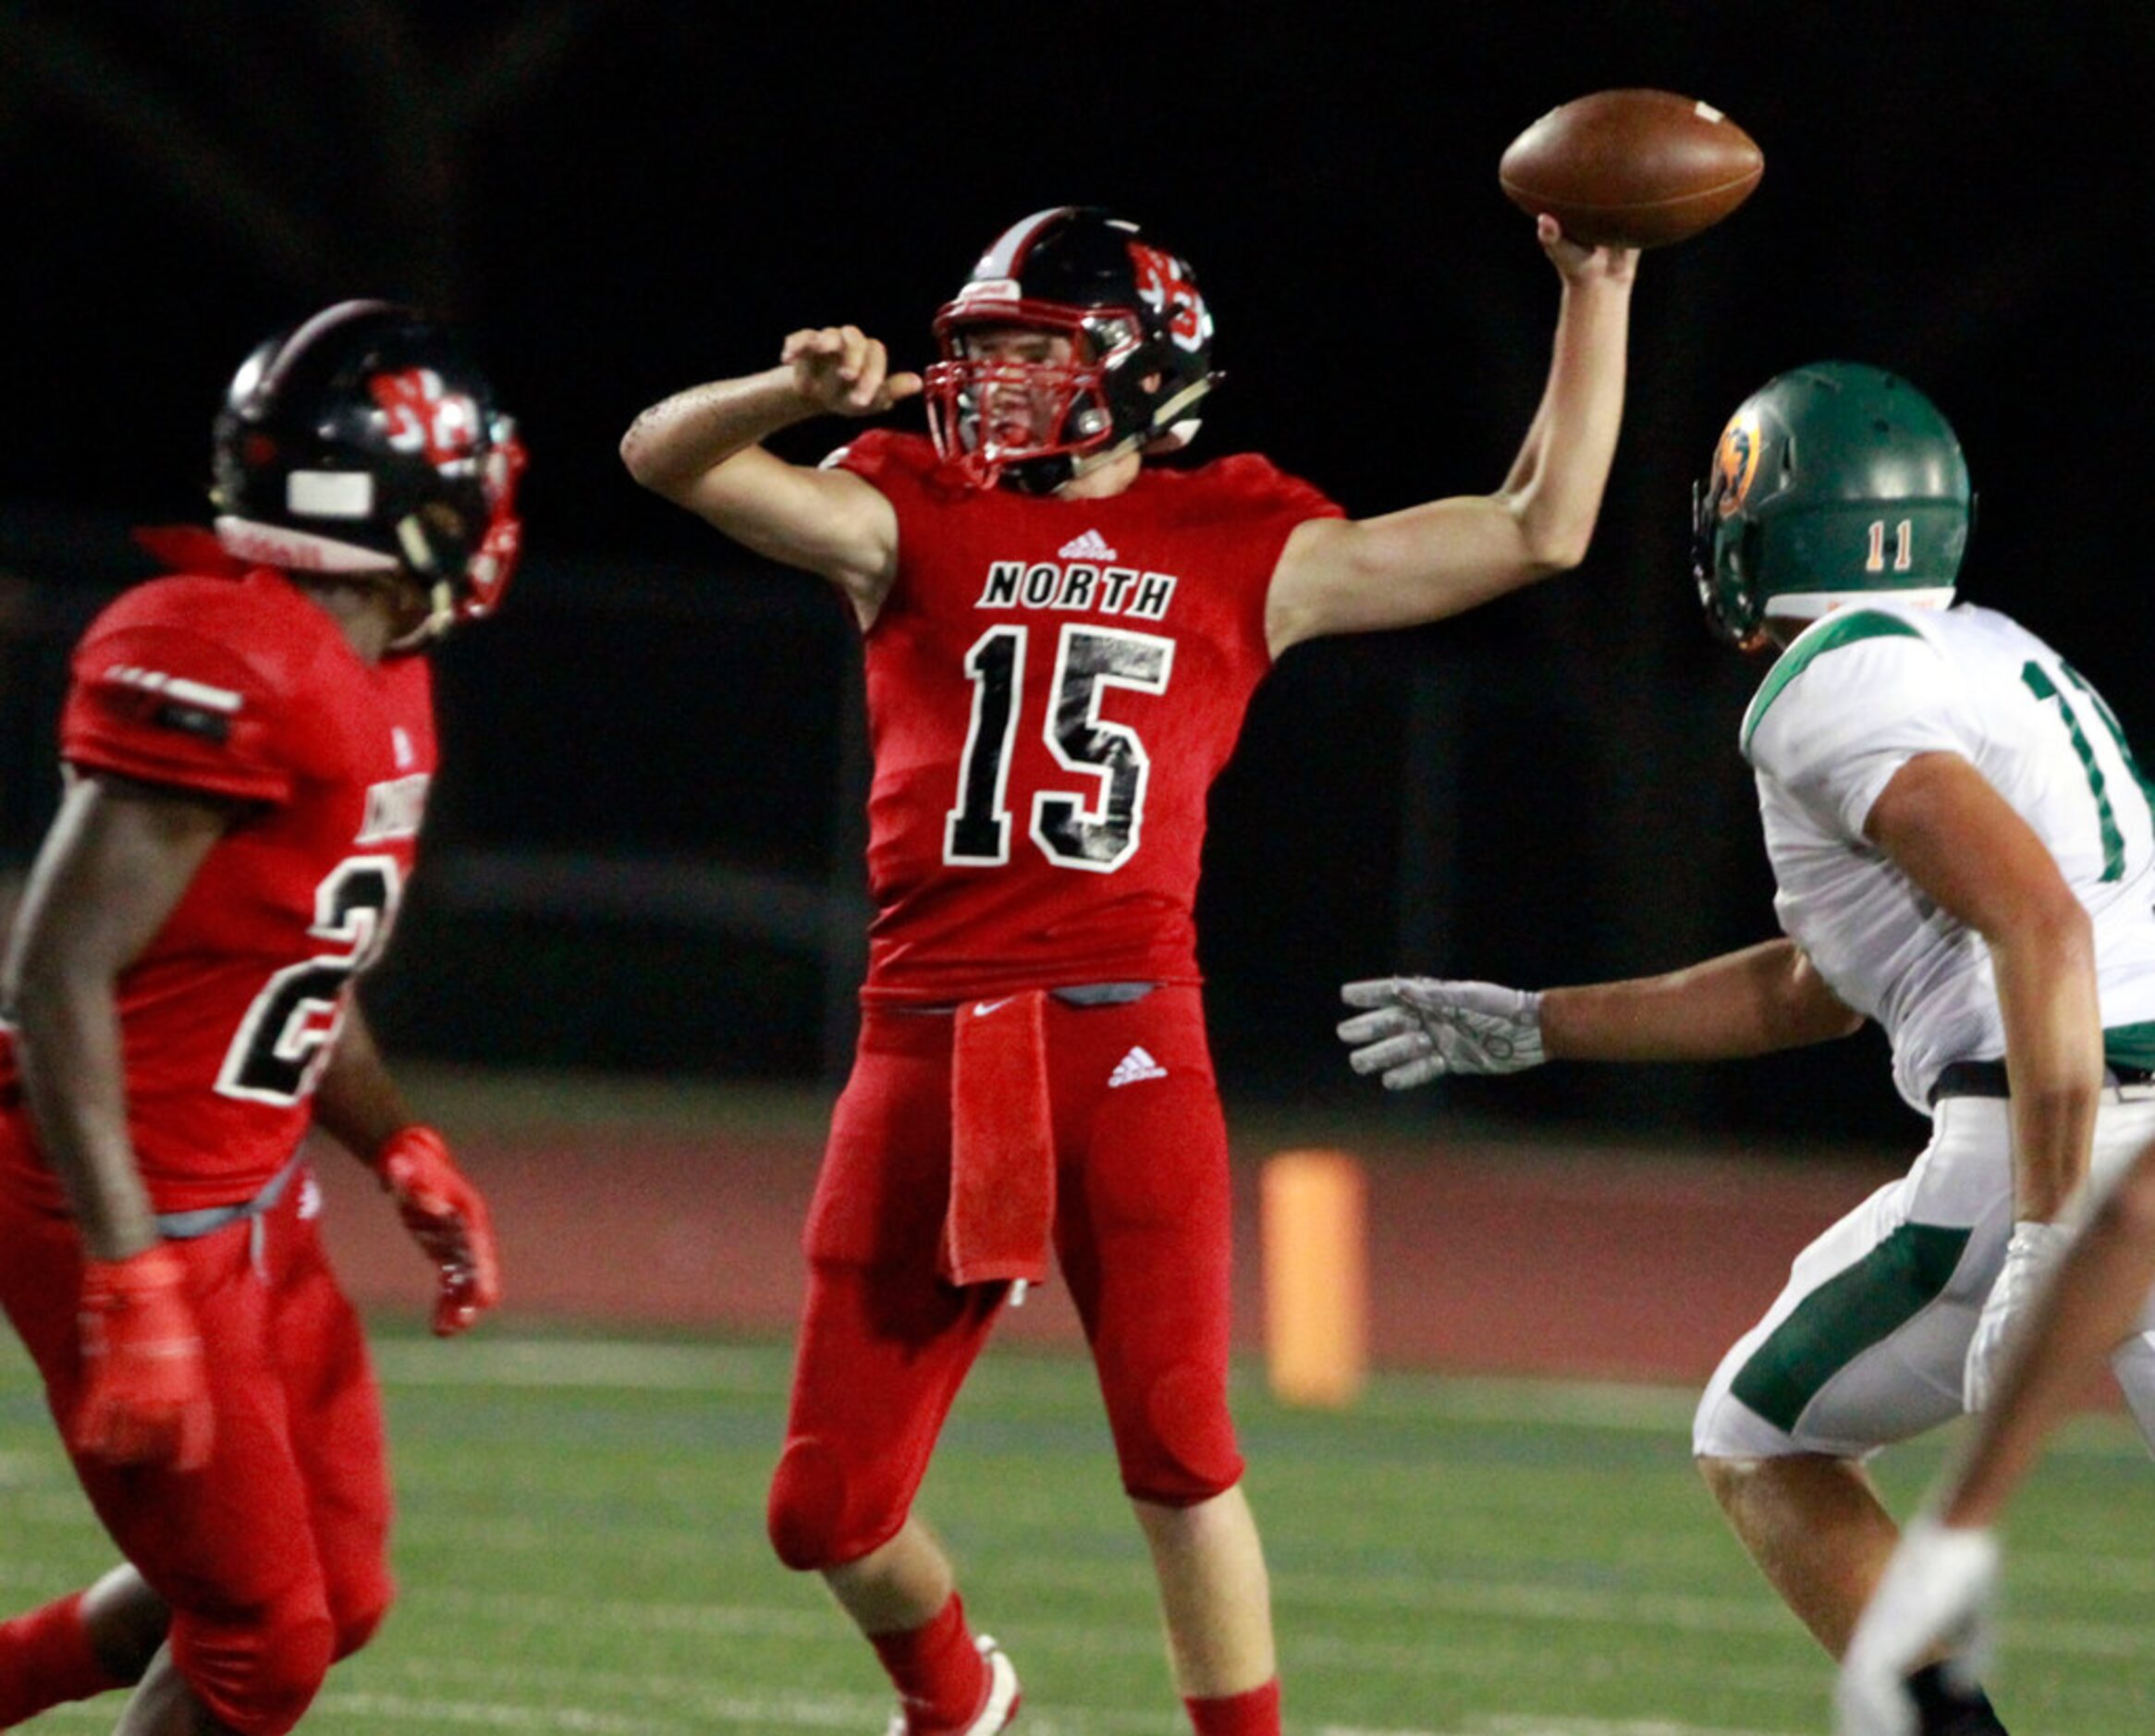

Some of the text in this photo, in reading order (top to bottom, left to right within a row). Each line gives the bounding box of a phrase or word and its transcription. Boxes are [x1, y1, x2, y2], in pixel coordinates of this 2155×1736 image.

[974, 561, 1178, 621] NORTH
[1866, 520, 1911, 571] 11
[943, 622, 1176, 874] 15
[213, 855, 402, 1106] 2
